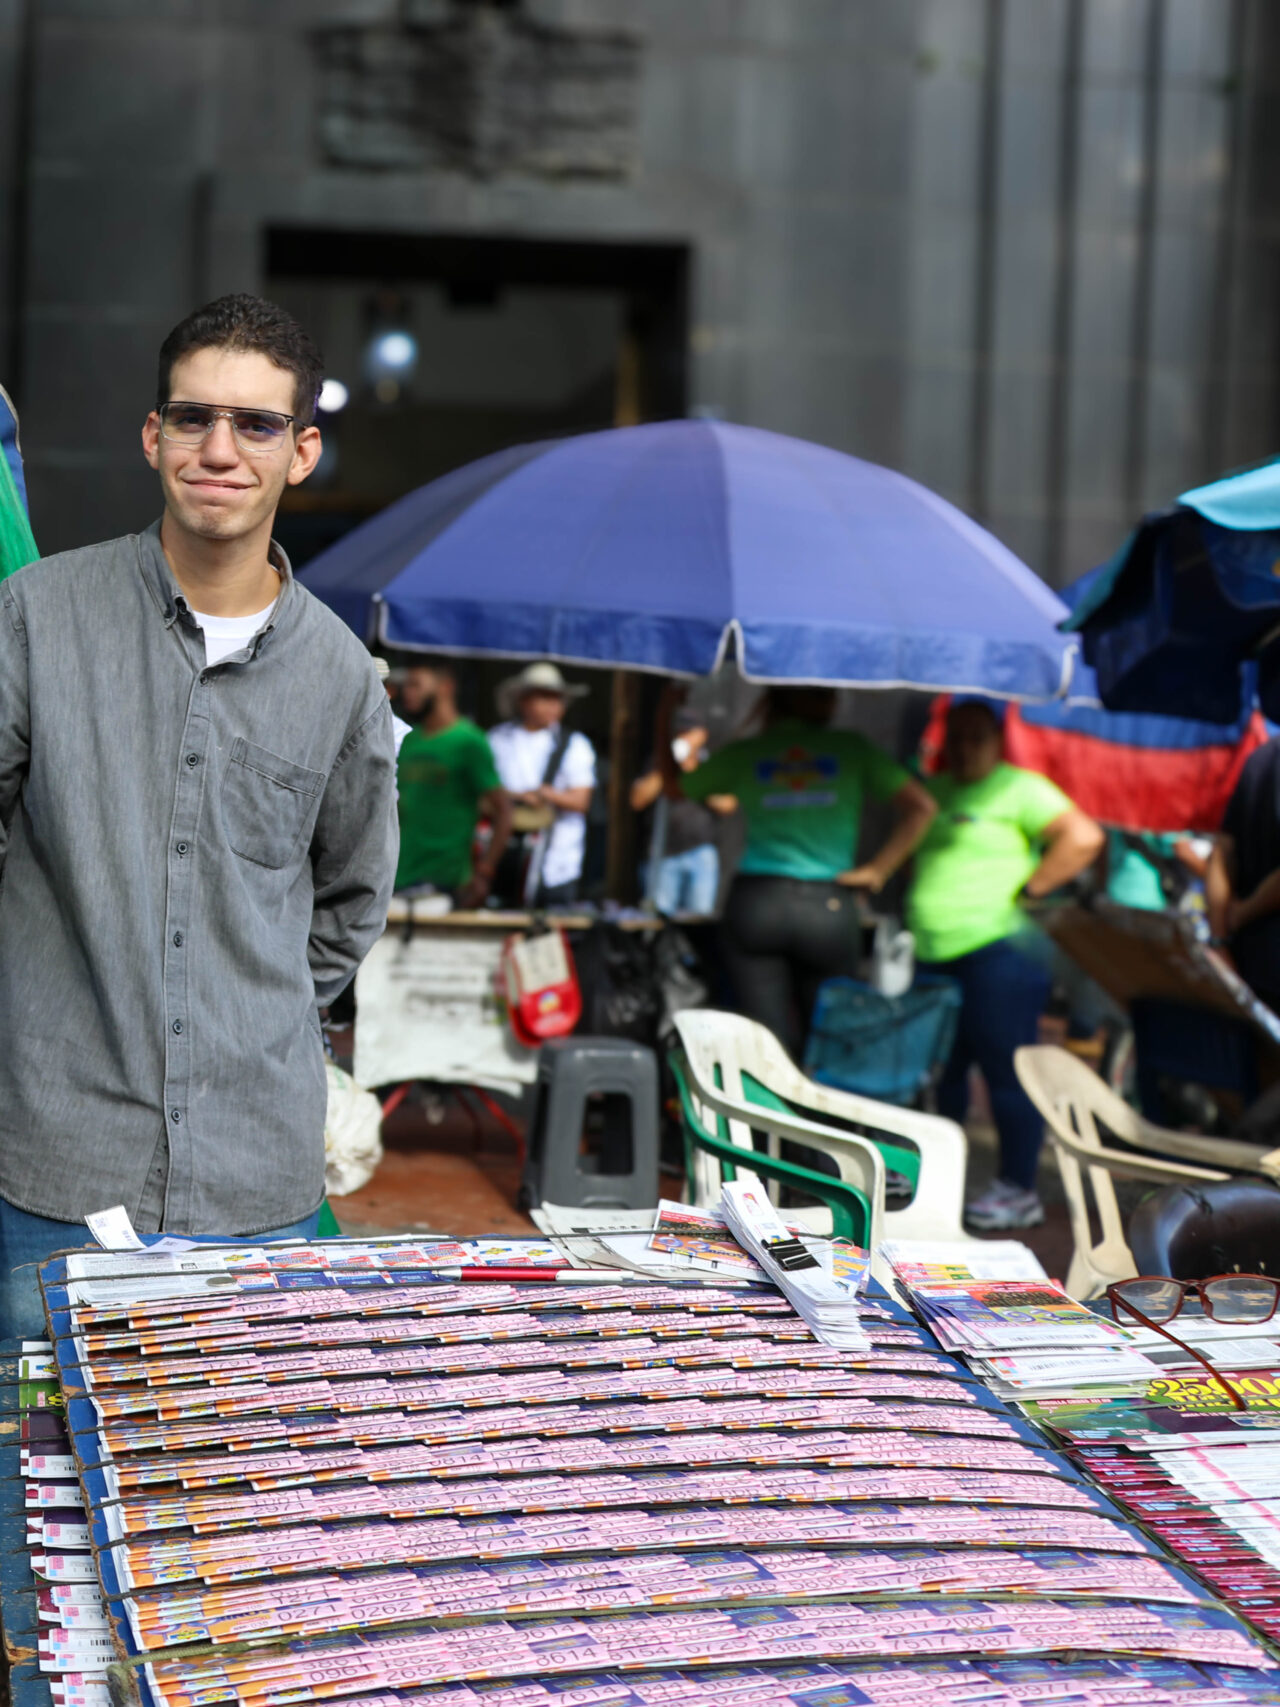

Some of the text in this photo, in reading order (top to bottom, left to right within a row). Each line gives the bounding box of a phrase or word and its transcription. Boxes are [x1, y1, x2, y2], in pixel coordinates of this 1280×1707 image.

[619, 1452, 669, 1462] 1095
[253, 1503, 304, 1514] 2971
[264, 1551, 319, 1564] 2671
[337, 1550, 392, 1561] 6172
[508, 1588, 564, 1602] 2714
[572, 1590, 632, 1605] 9954
[278, 1604, 336, 1621] 0271
[351, 1602, 410, 1619] 0262
[588, 1620, 648, 1636] 6454
[892, 1637, 947, 1650] 7517
[310, 1664, 370, 1682] 0961
[387, 1663, 449, 1682] 2652
[701, 1676, 763, 1691] 0025
[1010, 1682, 1070, 1698] 8977
[558, 1686, 617, 1703] 7614
